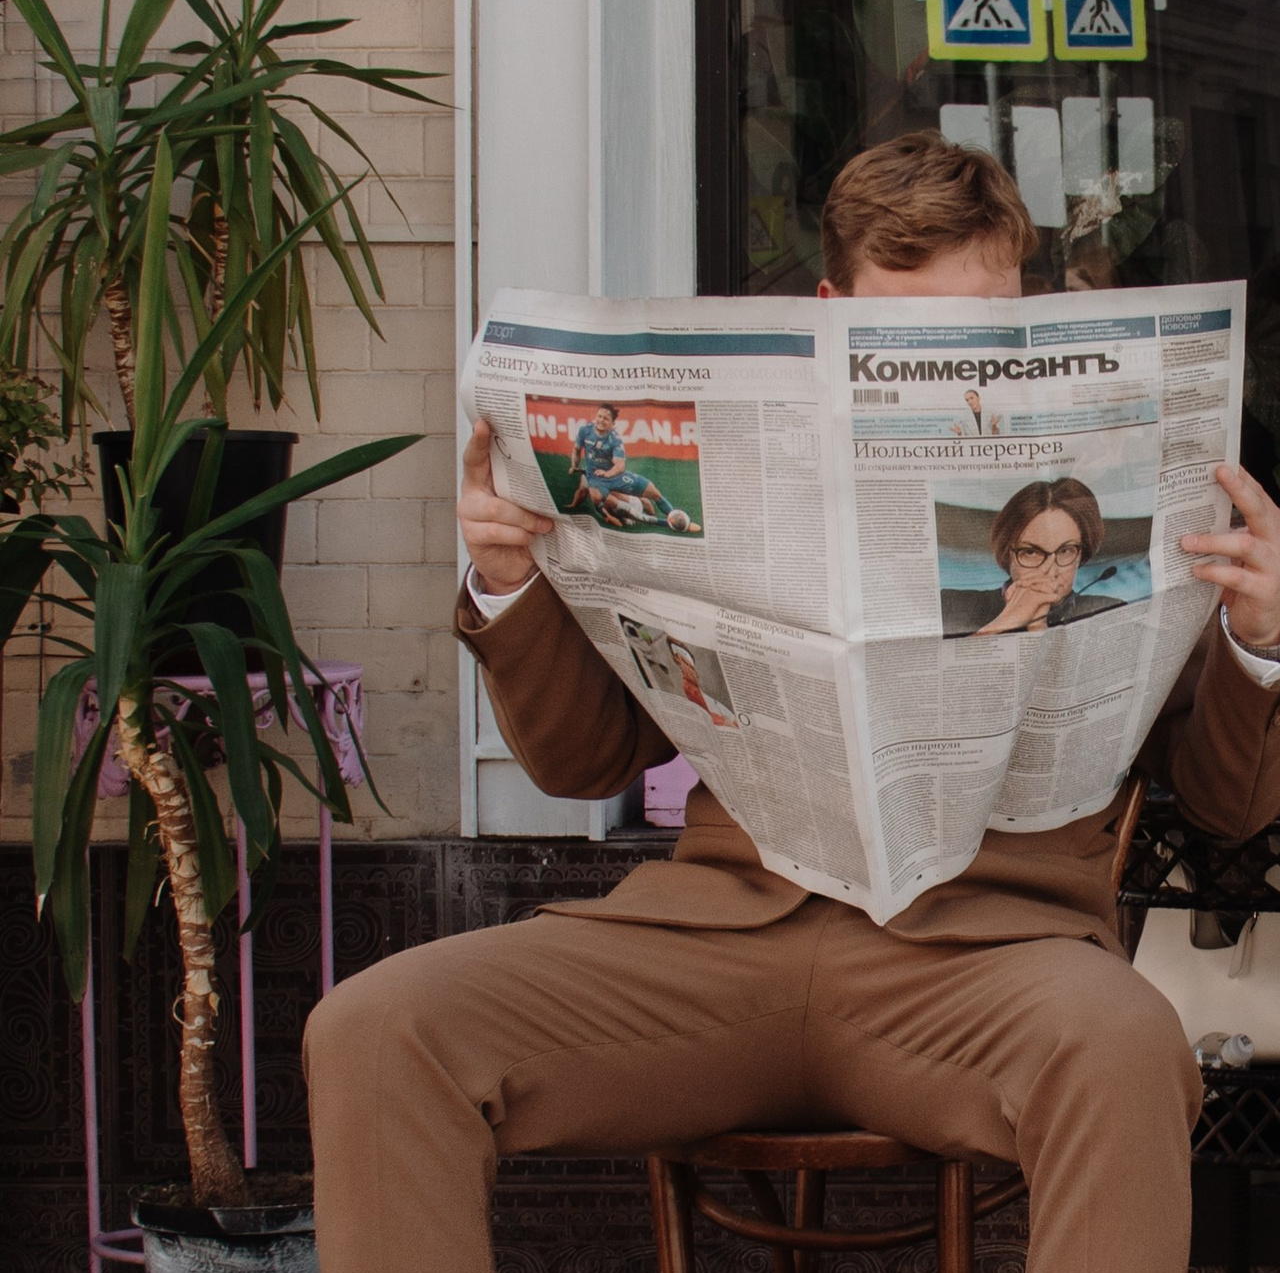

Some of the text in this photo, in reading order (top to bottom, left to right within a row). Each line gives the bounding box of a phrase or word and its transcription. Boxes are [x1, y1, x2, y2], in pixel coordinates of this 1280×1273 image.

[541, 361, 609, 380] хватило
[611, 364, 713, 384] минимума
[849, 352, 1120, 388] Коммерсантъ
[854, 440, 1064, 461] Июльский перегрев
